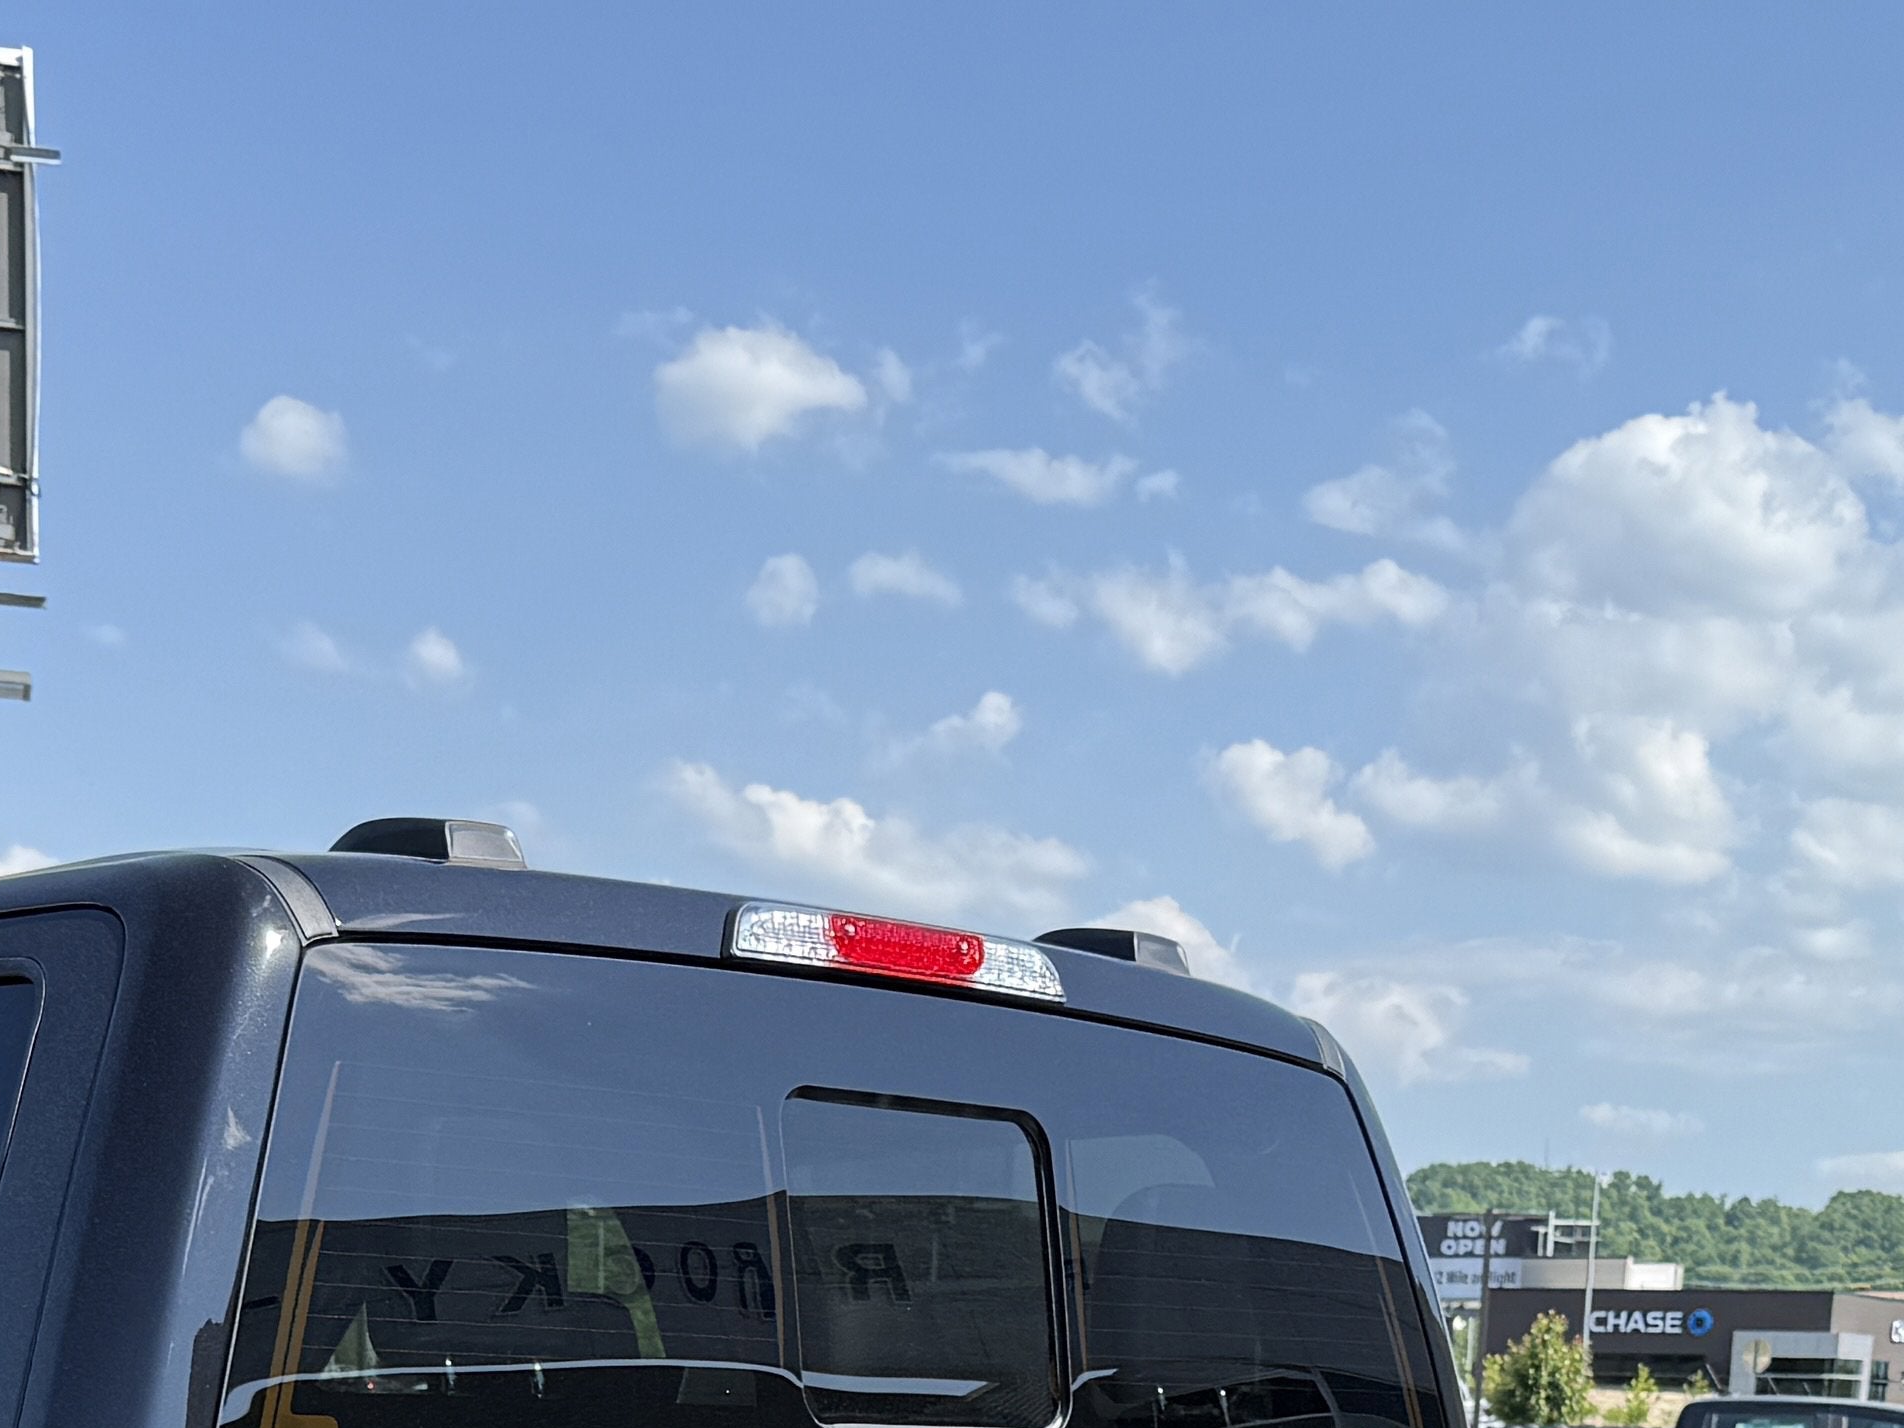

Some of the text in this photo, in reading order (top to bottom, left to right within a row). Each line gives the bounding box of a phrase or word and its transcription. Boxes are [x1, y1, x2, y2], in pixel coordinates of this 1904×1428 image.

[1440, 1239, 1508, 1256] OPEN
[1487, 1271, 1517, 1287] ight
[1589, 1310, 1683, 1334] CHASE
